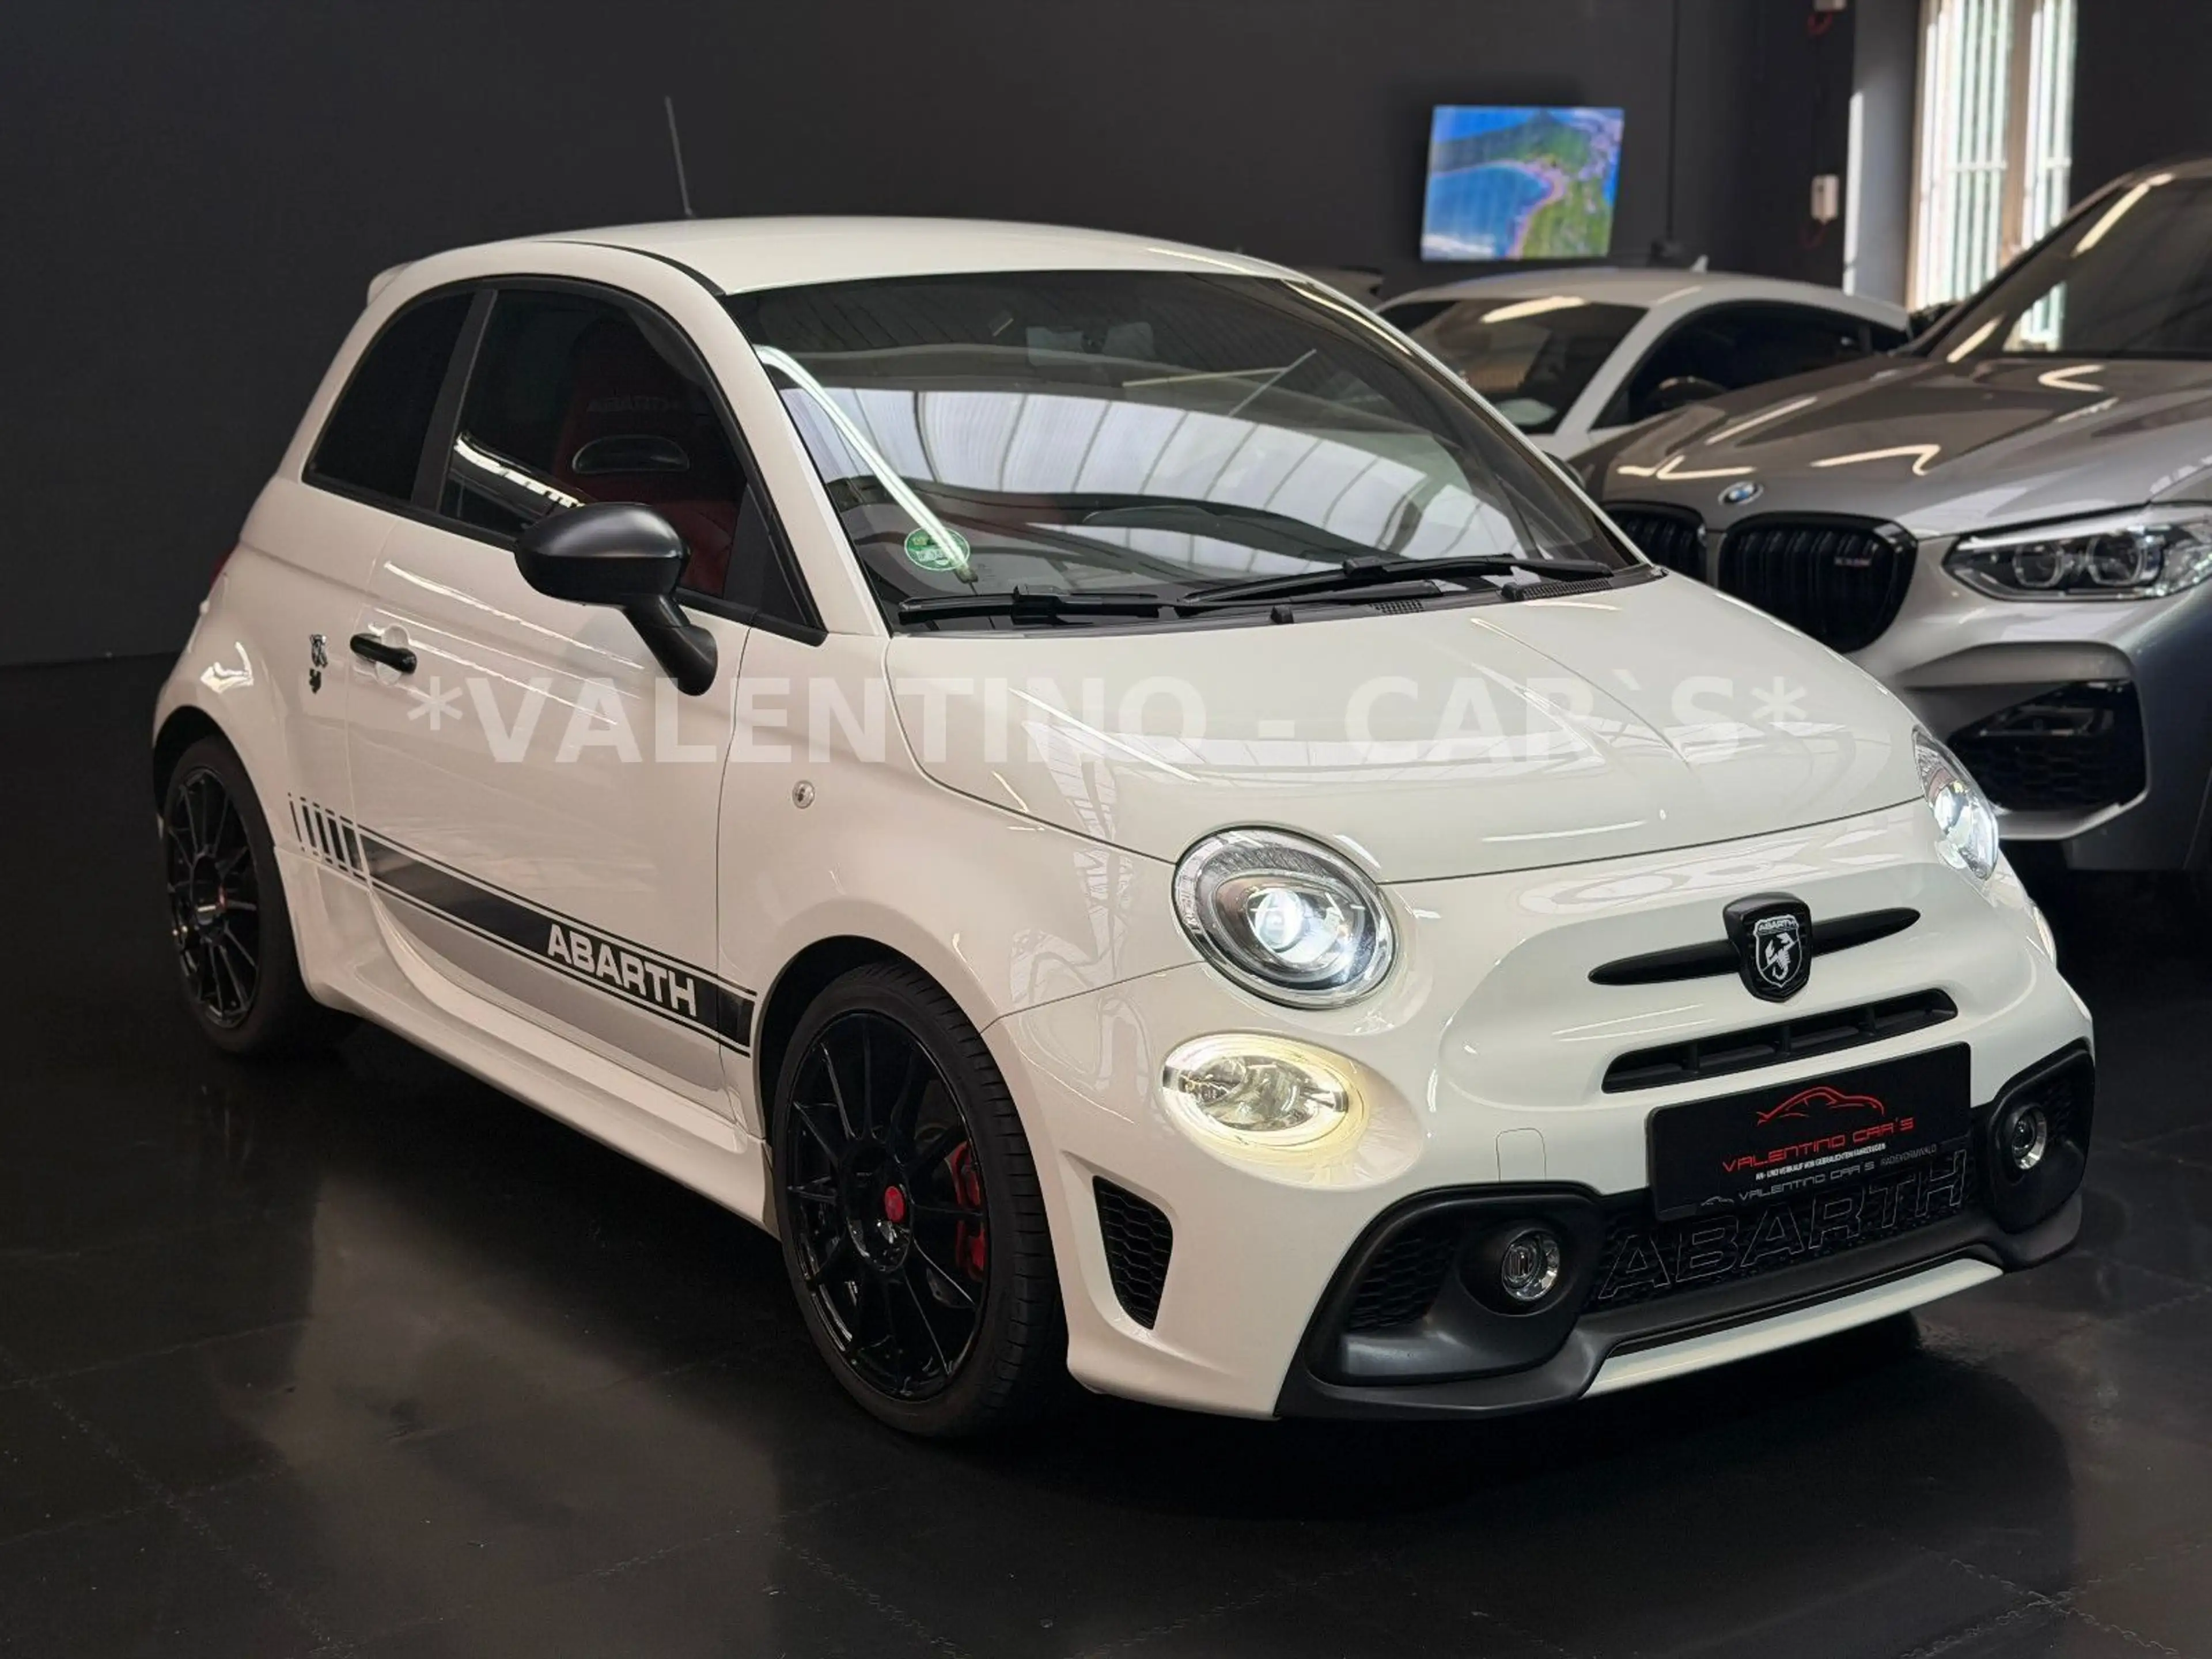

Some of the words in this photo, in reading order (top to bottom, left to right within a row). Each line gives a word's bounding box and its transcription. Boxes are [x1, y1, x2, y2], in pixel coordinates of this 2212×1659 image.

[1759, 919, 1797, 931] ABARTH
[548, 924, 697, 1017] ABARTH
[1722, 1135, 1845, 1172] VALENTINO
[1738, 1173, 1825, 1200] VALENTINO
[1599, 1149, 1966, 1300] ABARTH
